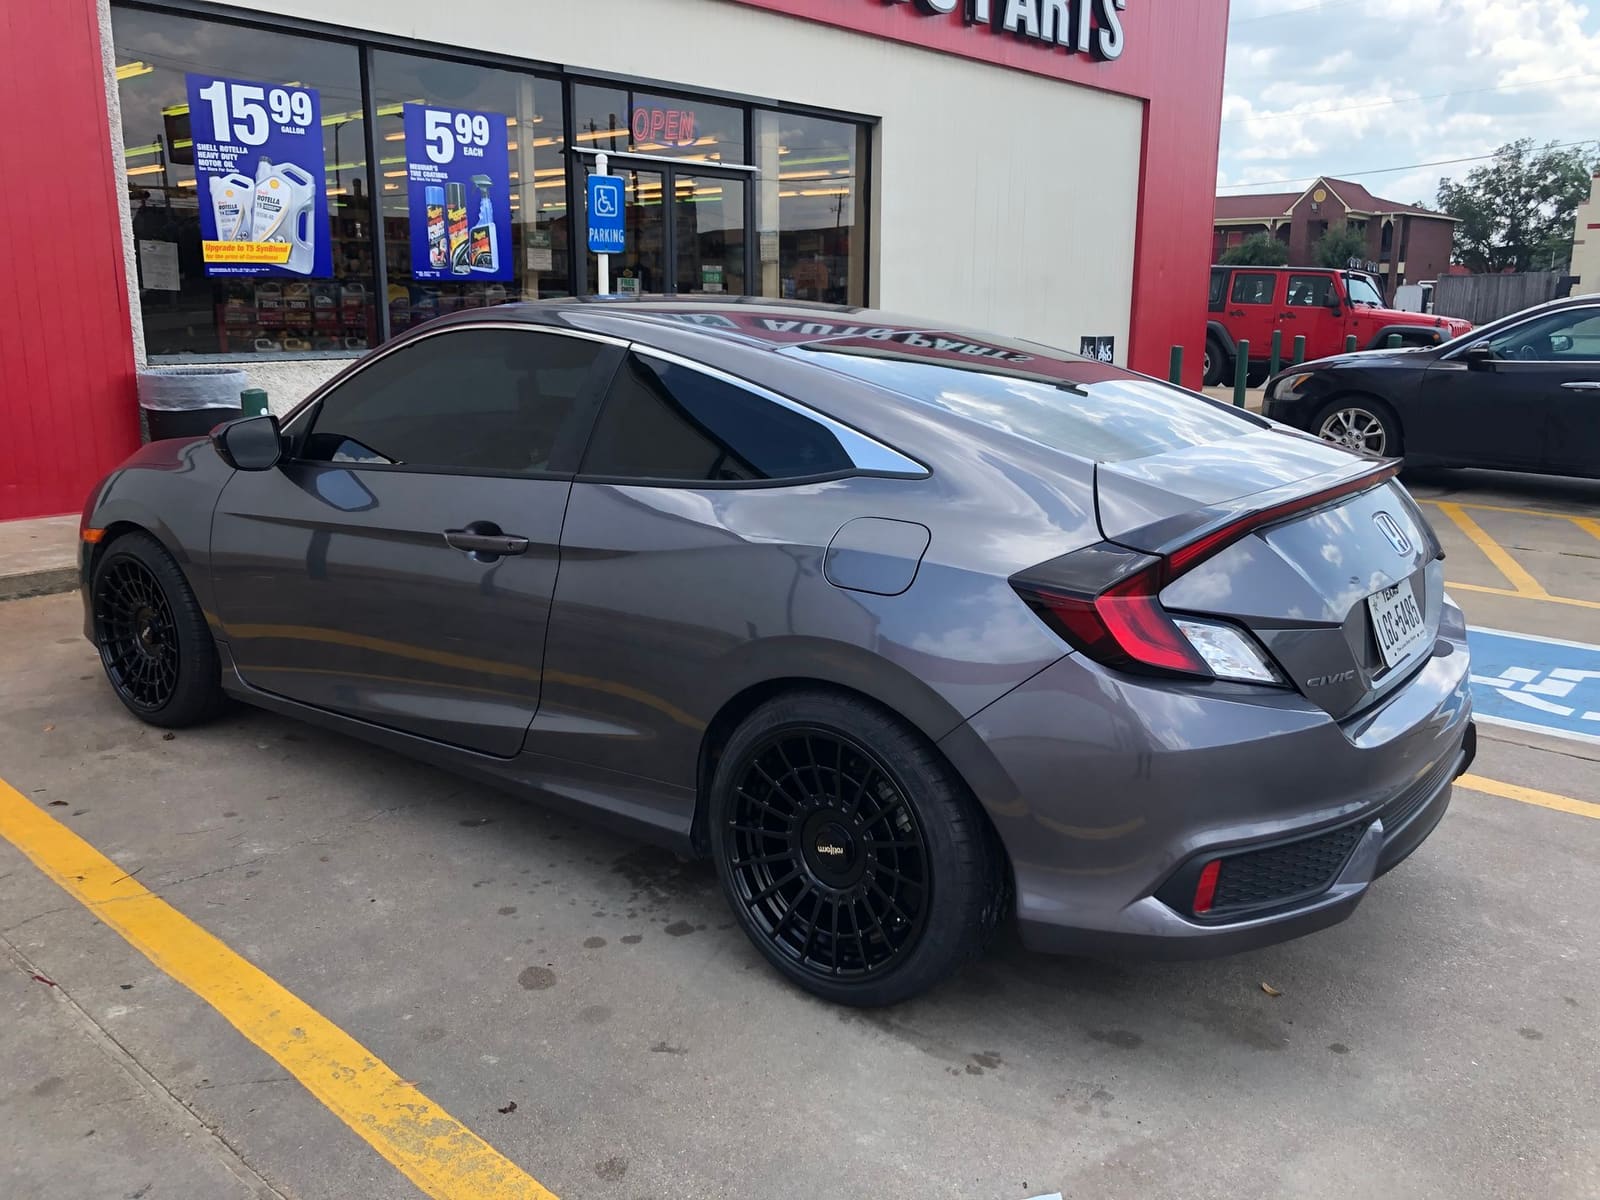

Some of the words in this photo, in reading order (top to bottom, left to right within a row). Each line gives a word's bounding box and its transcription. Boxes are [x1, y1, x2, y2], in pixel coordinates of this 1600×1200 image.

[632, 108, 695, 141] OPEN
[281, 126, 305, 135] GALLON
[197, 143, 218, 152] SHELL
[220, 145, 248, 154] ROTELLA
[463, 147, 483, 157] EACH
[198, 151, 219, 160] HEAVY
[221, 152, 238, 161] DUTY
[199, 159, 222, 167] MOTOR
[224, 160, 235, 168] OIL
[256, 195, 280, 205] ROTELLA
[588, 227, 625, 243] PARKING
[205, 244, 236, 253] Upgrade
[1382, 587, 1400, 604] TEXAS
[1306, 669, 1355, 687] CIVIC
